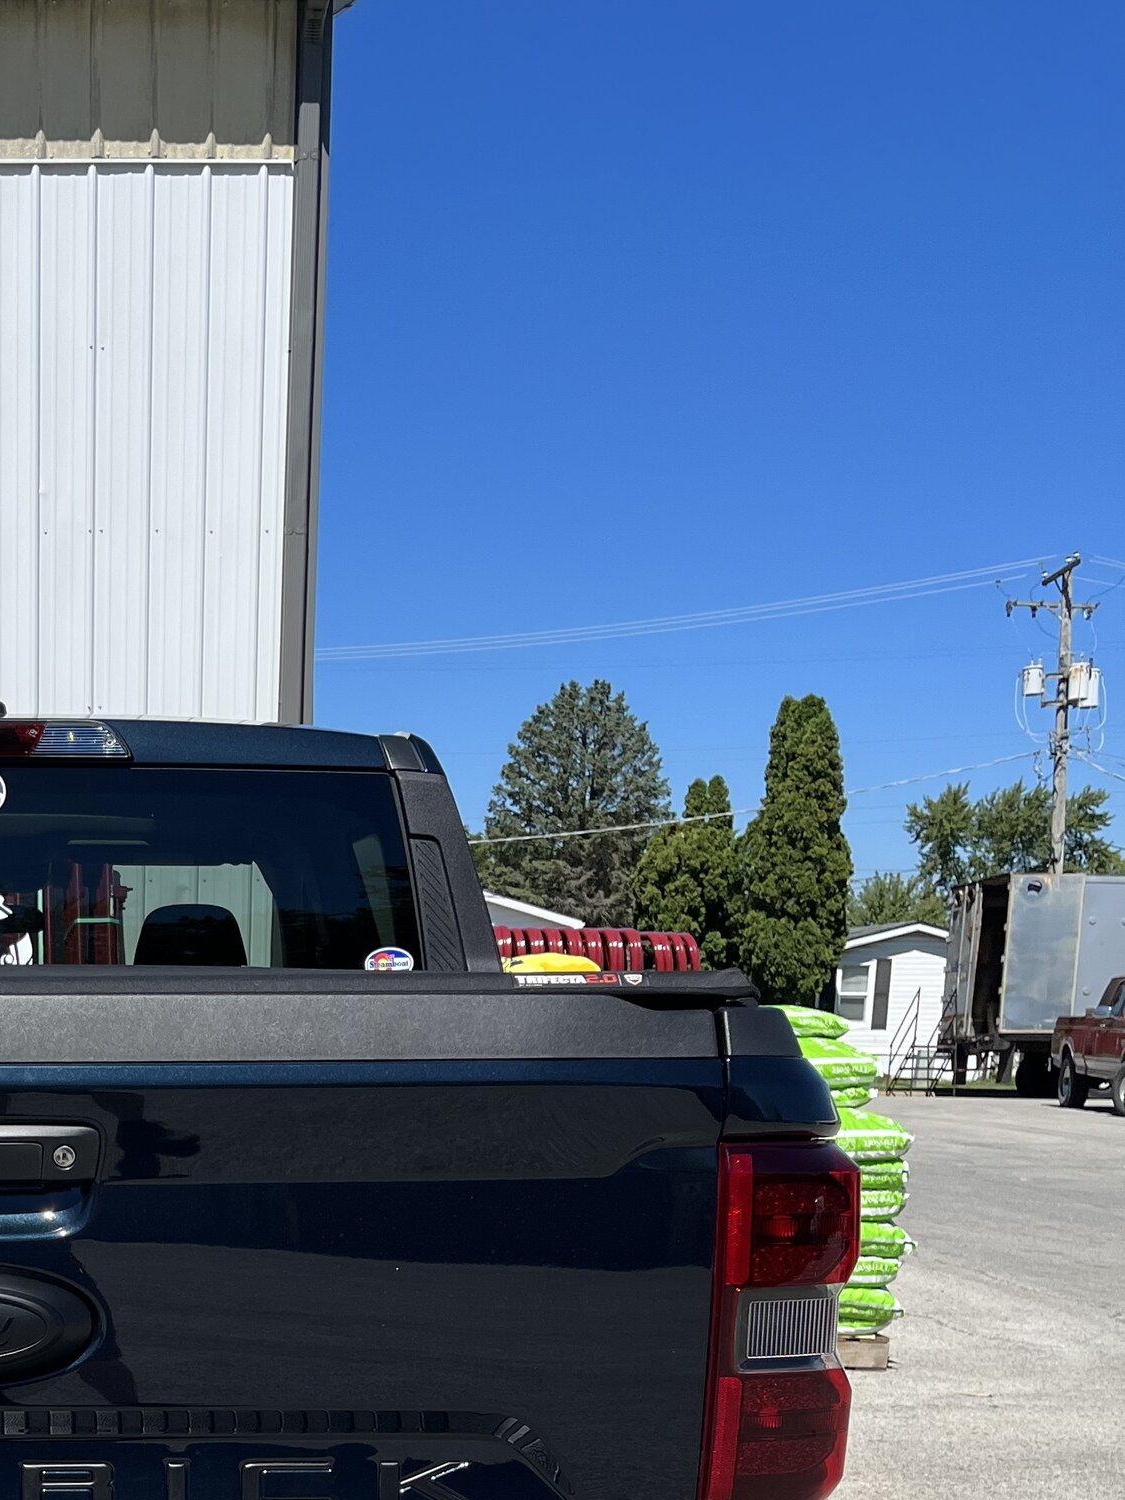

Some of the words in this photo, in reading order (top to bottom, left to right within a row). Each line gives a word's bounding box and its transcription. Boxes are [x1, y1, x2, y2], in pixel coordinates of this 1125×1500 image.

[369, 961, 409, 969] Steamboat
[514, 975, 587, 984] TRIFECTA
[586, 974, 617, 983] 2.0
